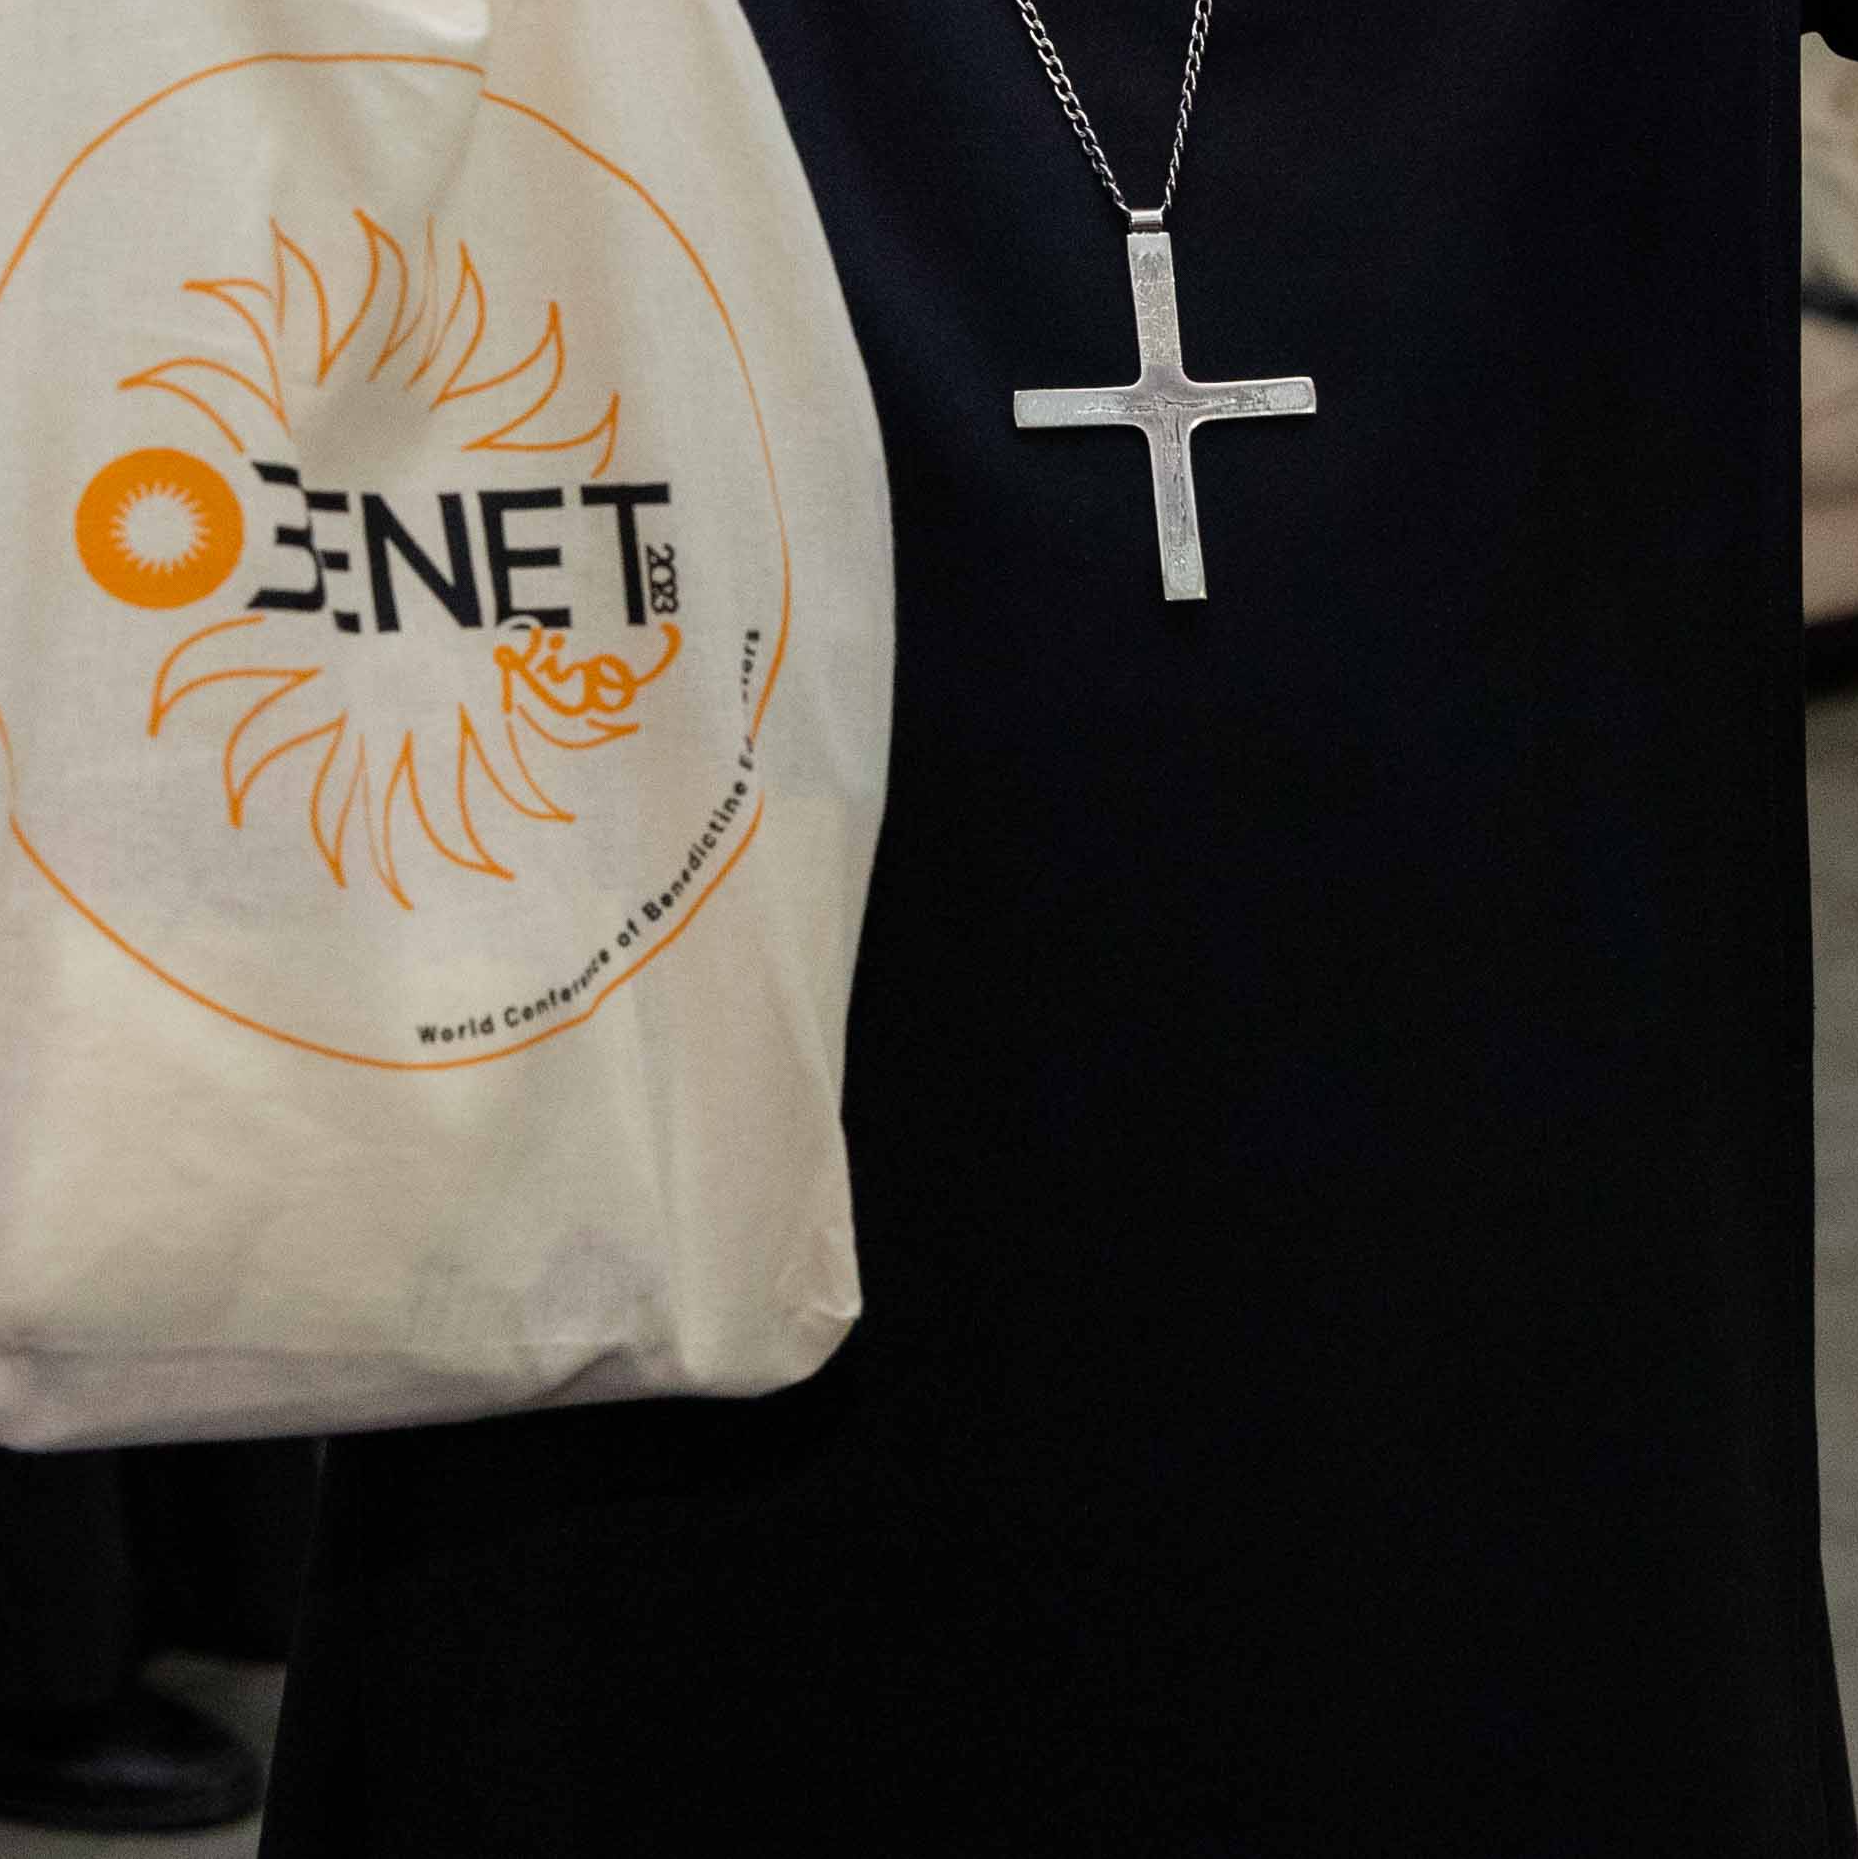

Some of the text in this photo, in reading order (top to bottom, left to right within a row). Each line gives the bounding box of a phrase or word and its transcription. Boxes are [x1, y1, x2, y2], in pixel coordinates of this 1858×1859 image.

[493, 620, 684, 718] Rio
[416, 1013, 496, 1044] World
[615, 918, 642, 950] of
[642, 780, 748, 925] Benedictine
